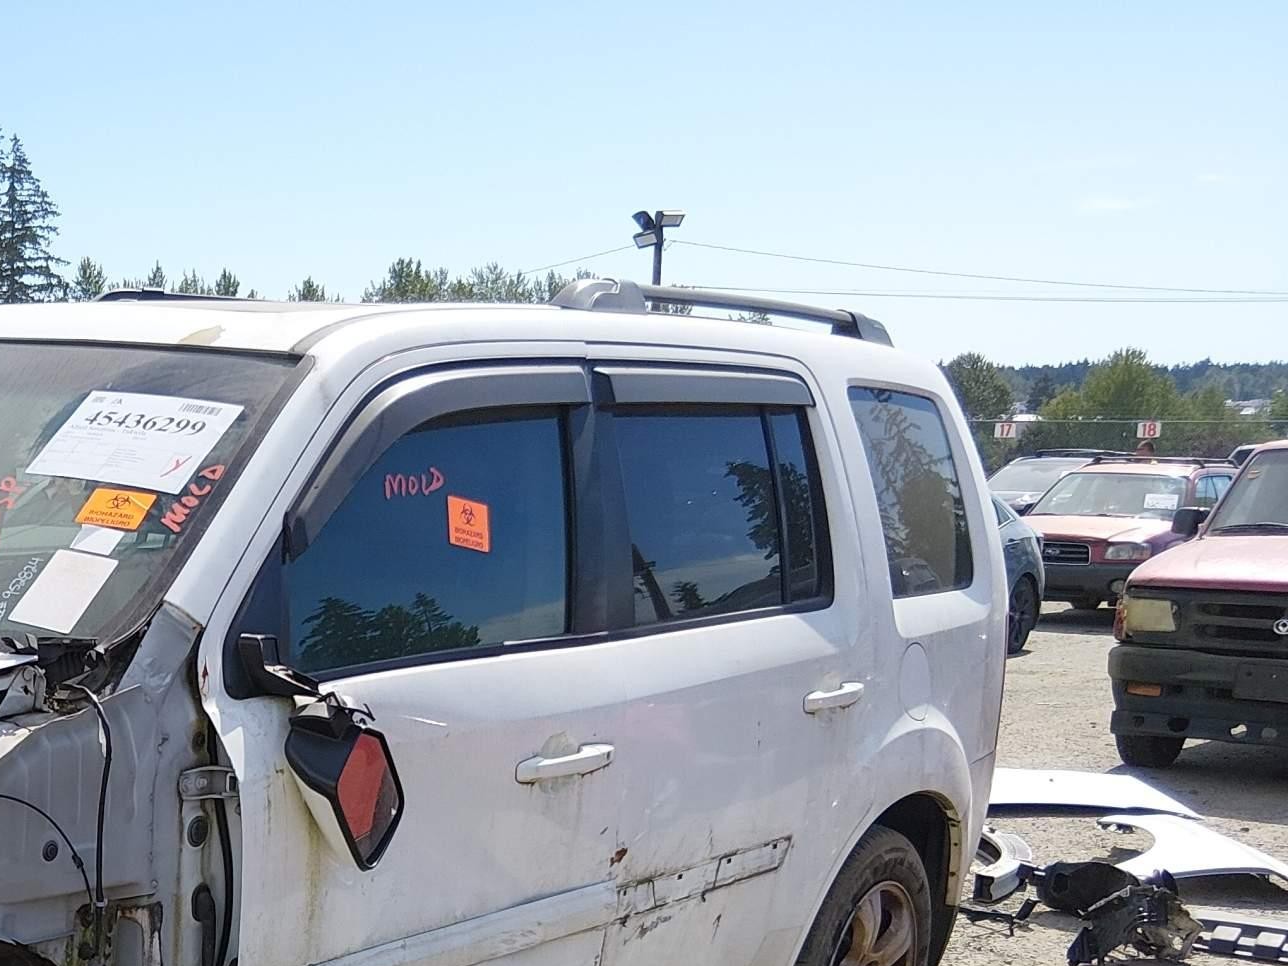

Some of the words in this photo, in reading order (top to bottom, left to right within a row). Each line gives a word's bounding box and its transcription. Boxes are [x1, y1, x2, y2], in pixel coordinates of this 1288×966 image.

[84, 410, 207, 437] 45436299
[1000, 423, 1012, 436] 17
[1141, 423, 1157, 437] 18
[385, 467, 444, 500] MOLD
[160, 464, 225, 533] MOLD
[88, 508, 135, 520] BIOHAZARD
